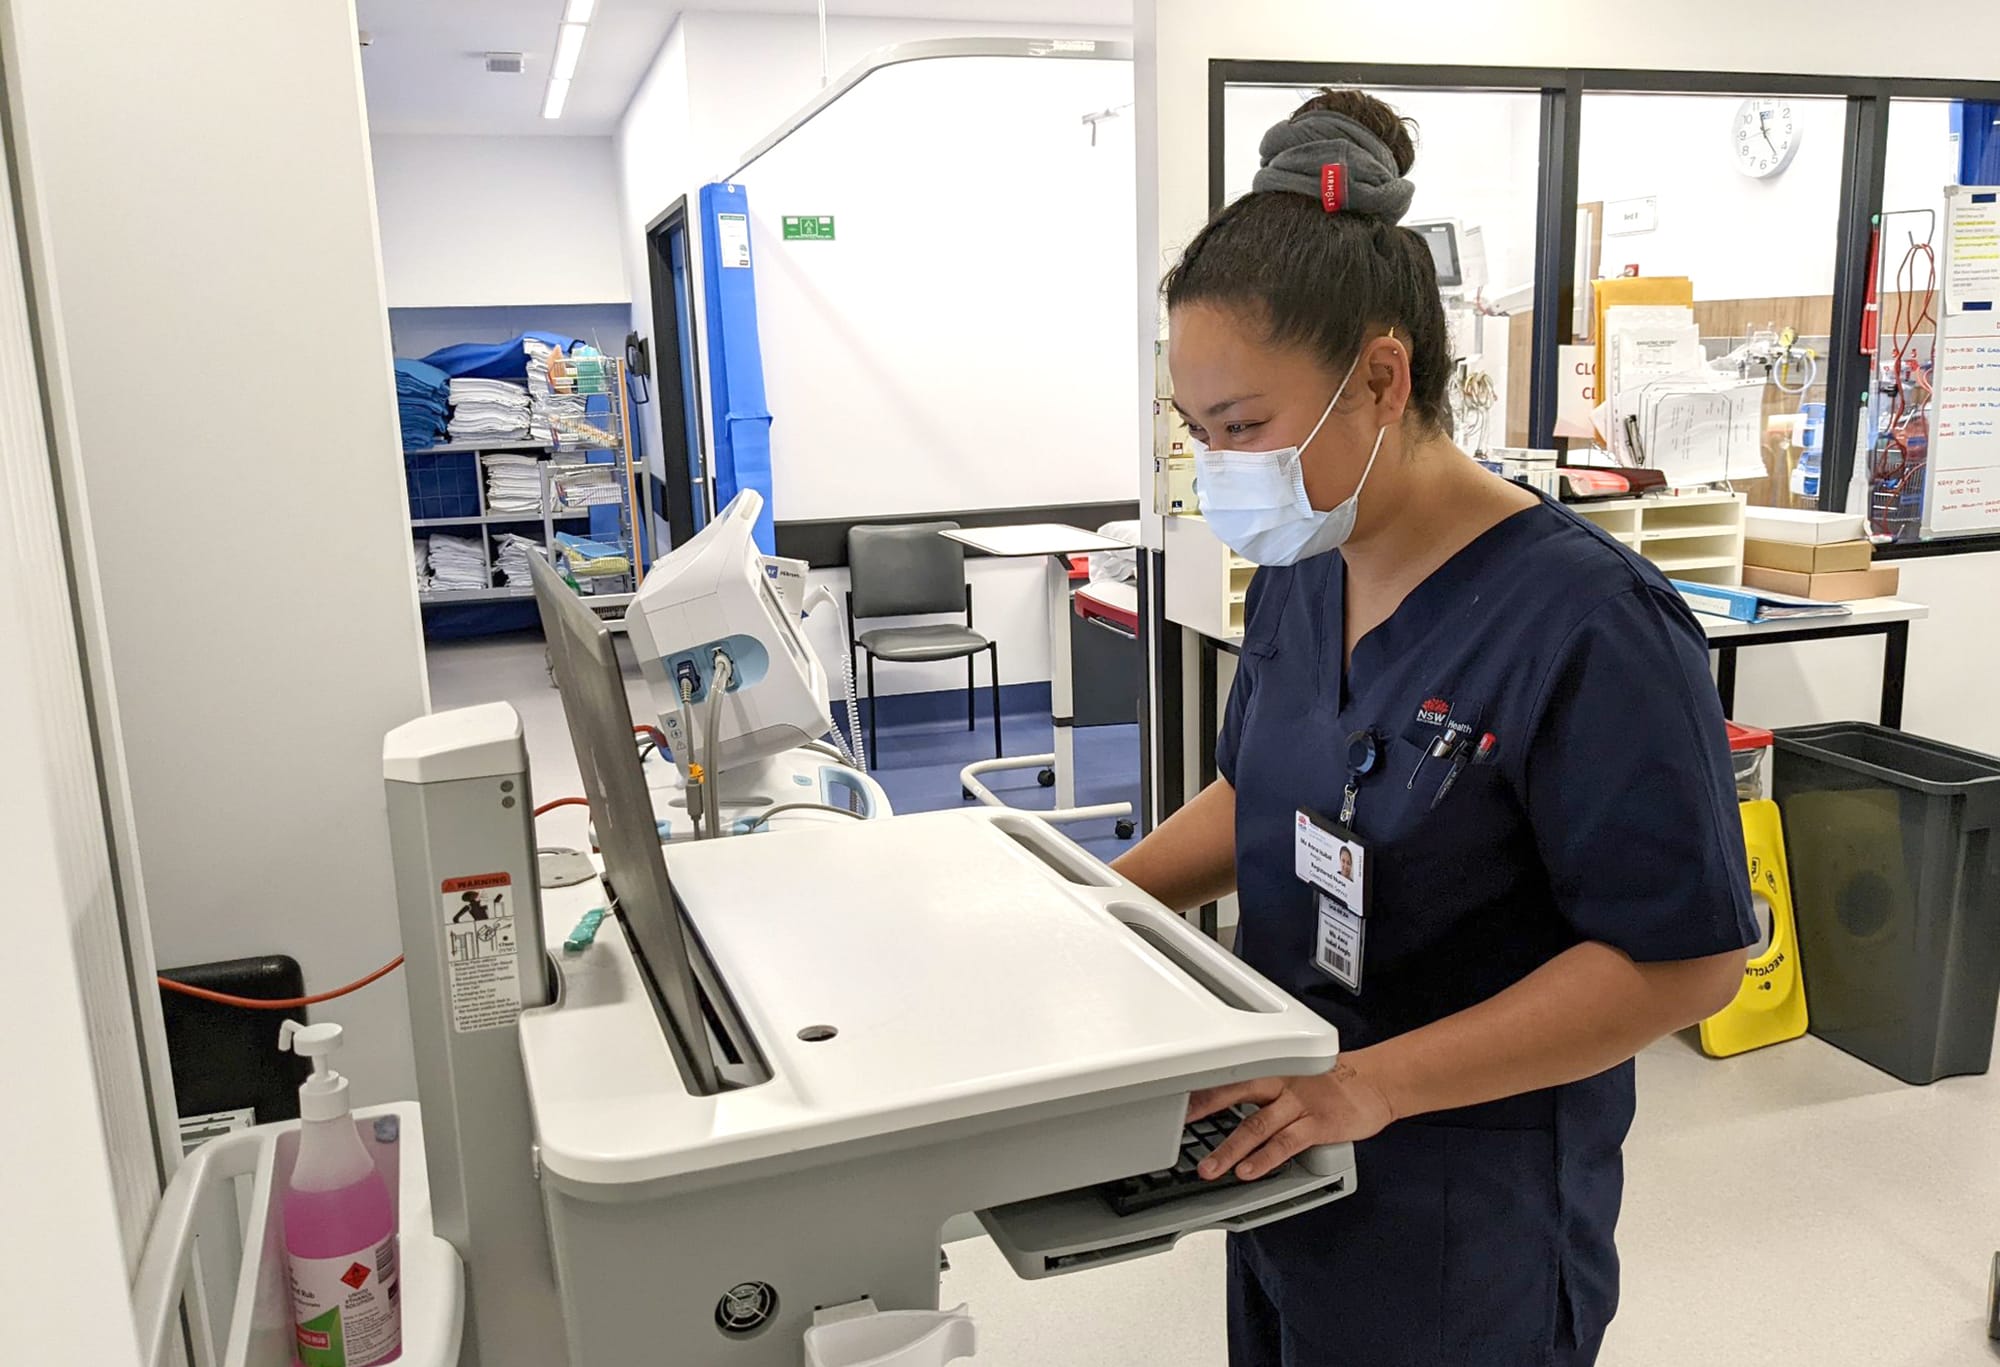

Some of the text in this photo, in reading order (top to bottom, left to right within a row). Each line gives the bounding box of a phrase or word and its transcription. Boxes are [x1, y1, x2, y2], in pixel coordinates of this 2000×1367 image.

[1743, 114, 1752, 124] 10
[1782, 108, 1790, 119] 2
[1786, 124, 1792, 134] 3
[1740, 130, 1746, 140] 9
[1742, 145, 1749, 156] 8
[1781, 141, 1787, 150] 4
[1750, 156, 1756, 167] 7
[1760, 159, 1767, 170] 6
[1771, 155, 1778, 164] 5
[1417, 709, 1447, 722] NSW
[1448, 720, 1472, 734] Health
[457, 875, 507, 889] WARNING
